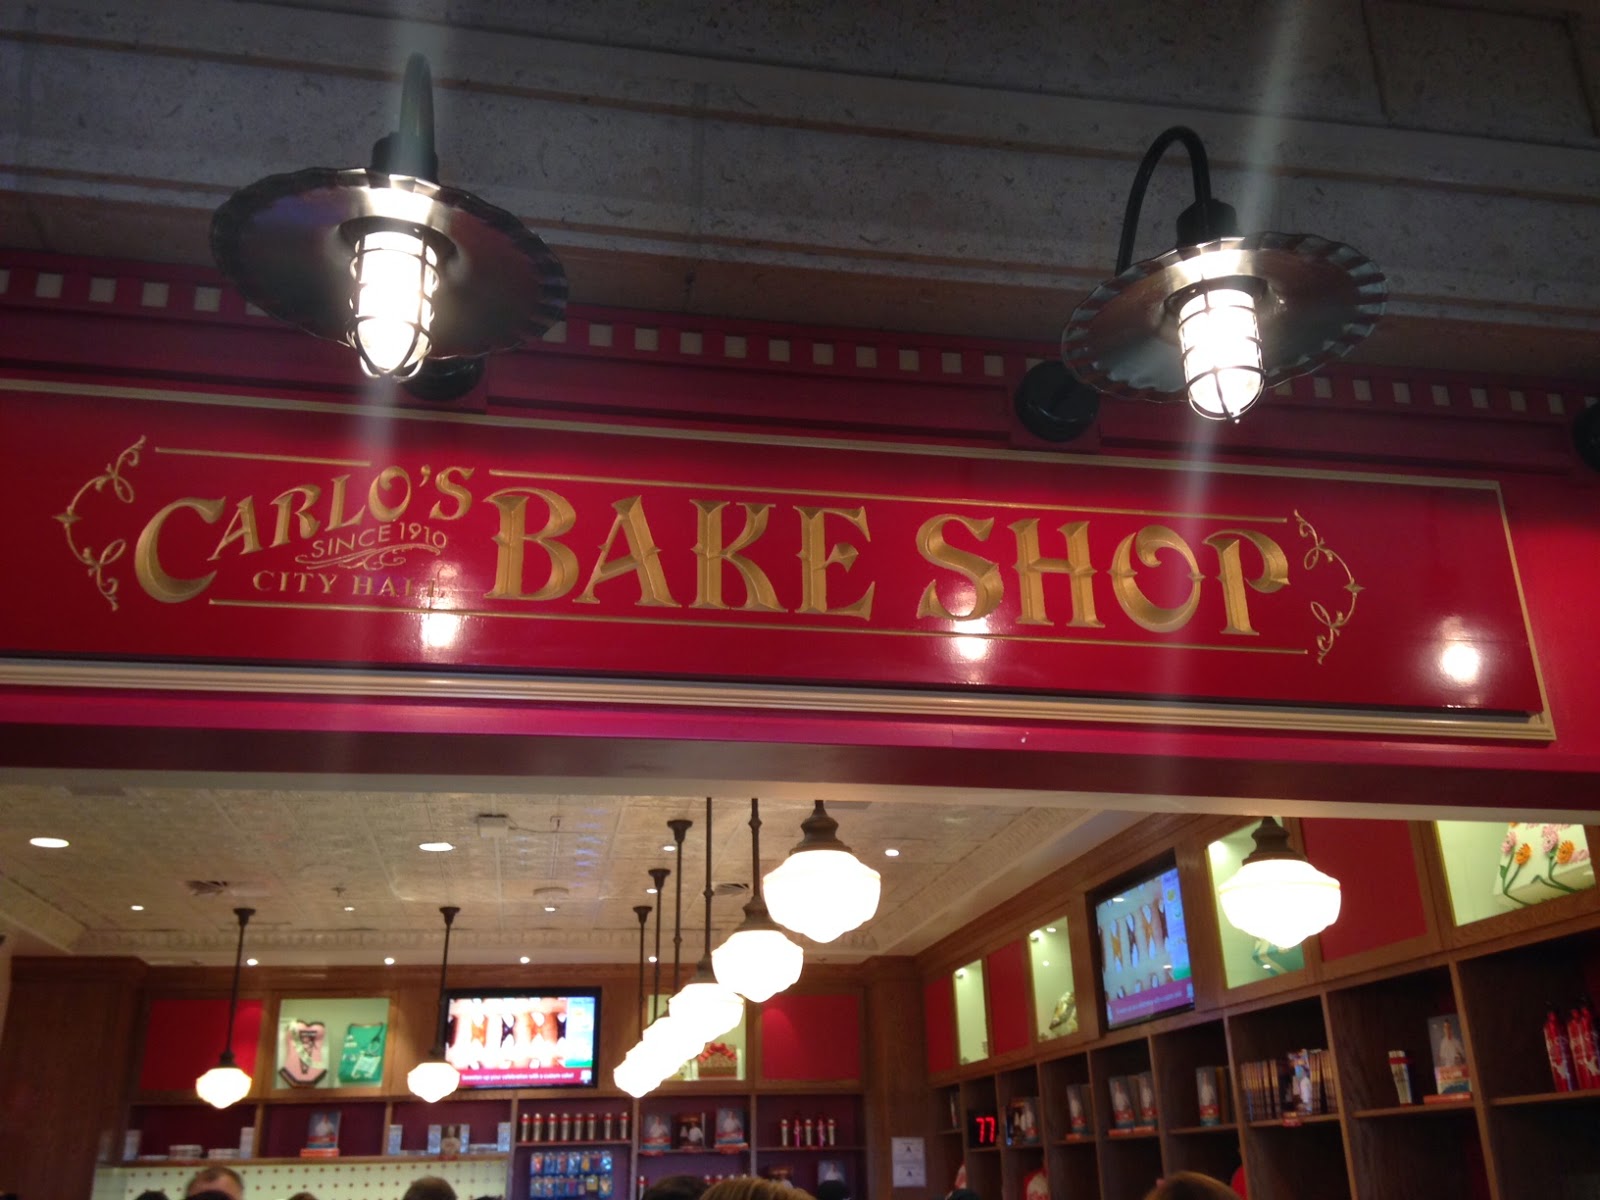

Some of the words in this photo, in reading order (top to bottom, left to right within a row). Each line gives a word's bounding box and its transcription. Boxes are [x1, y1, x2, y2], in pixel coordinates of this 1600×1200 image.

[134, 465, 475, 603] CARLO'S
[483, 487, 875, 621] BAKE
[916, 513, 1290, 636] SHOP
[311, 524, 391, 558] SINCE
[399, 522, 447, 549] 1910
[252, 570, 338, 594] CITY
[975, 1116, 995, 1143] 77
